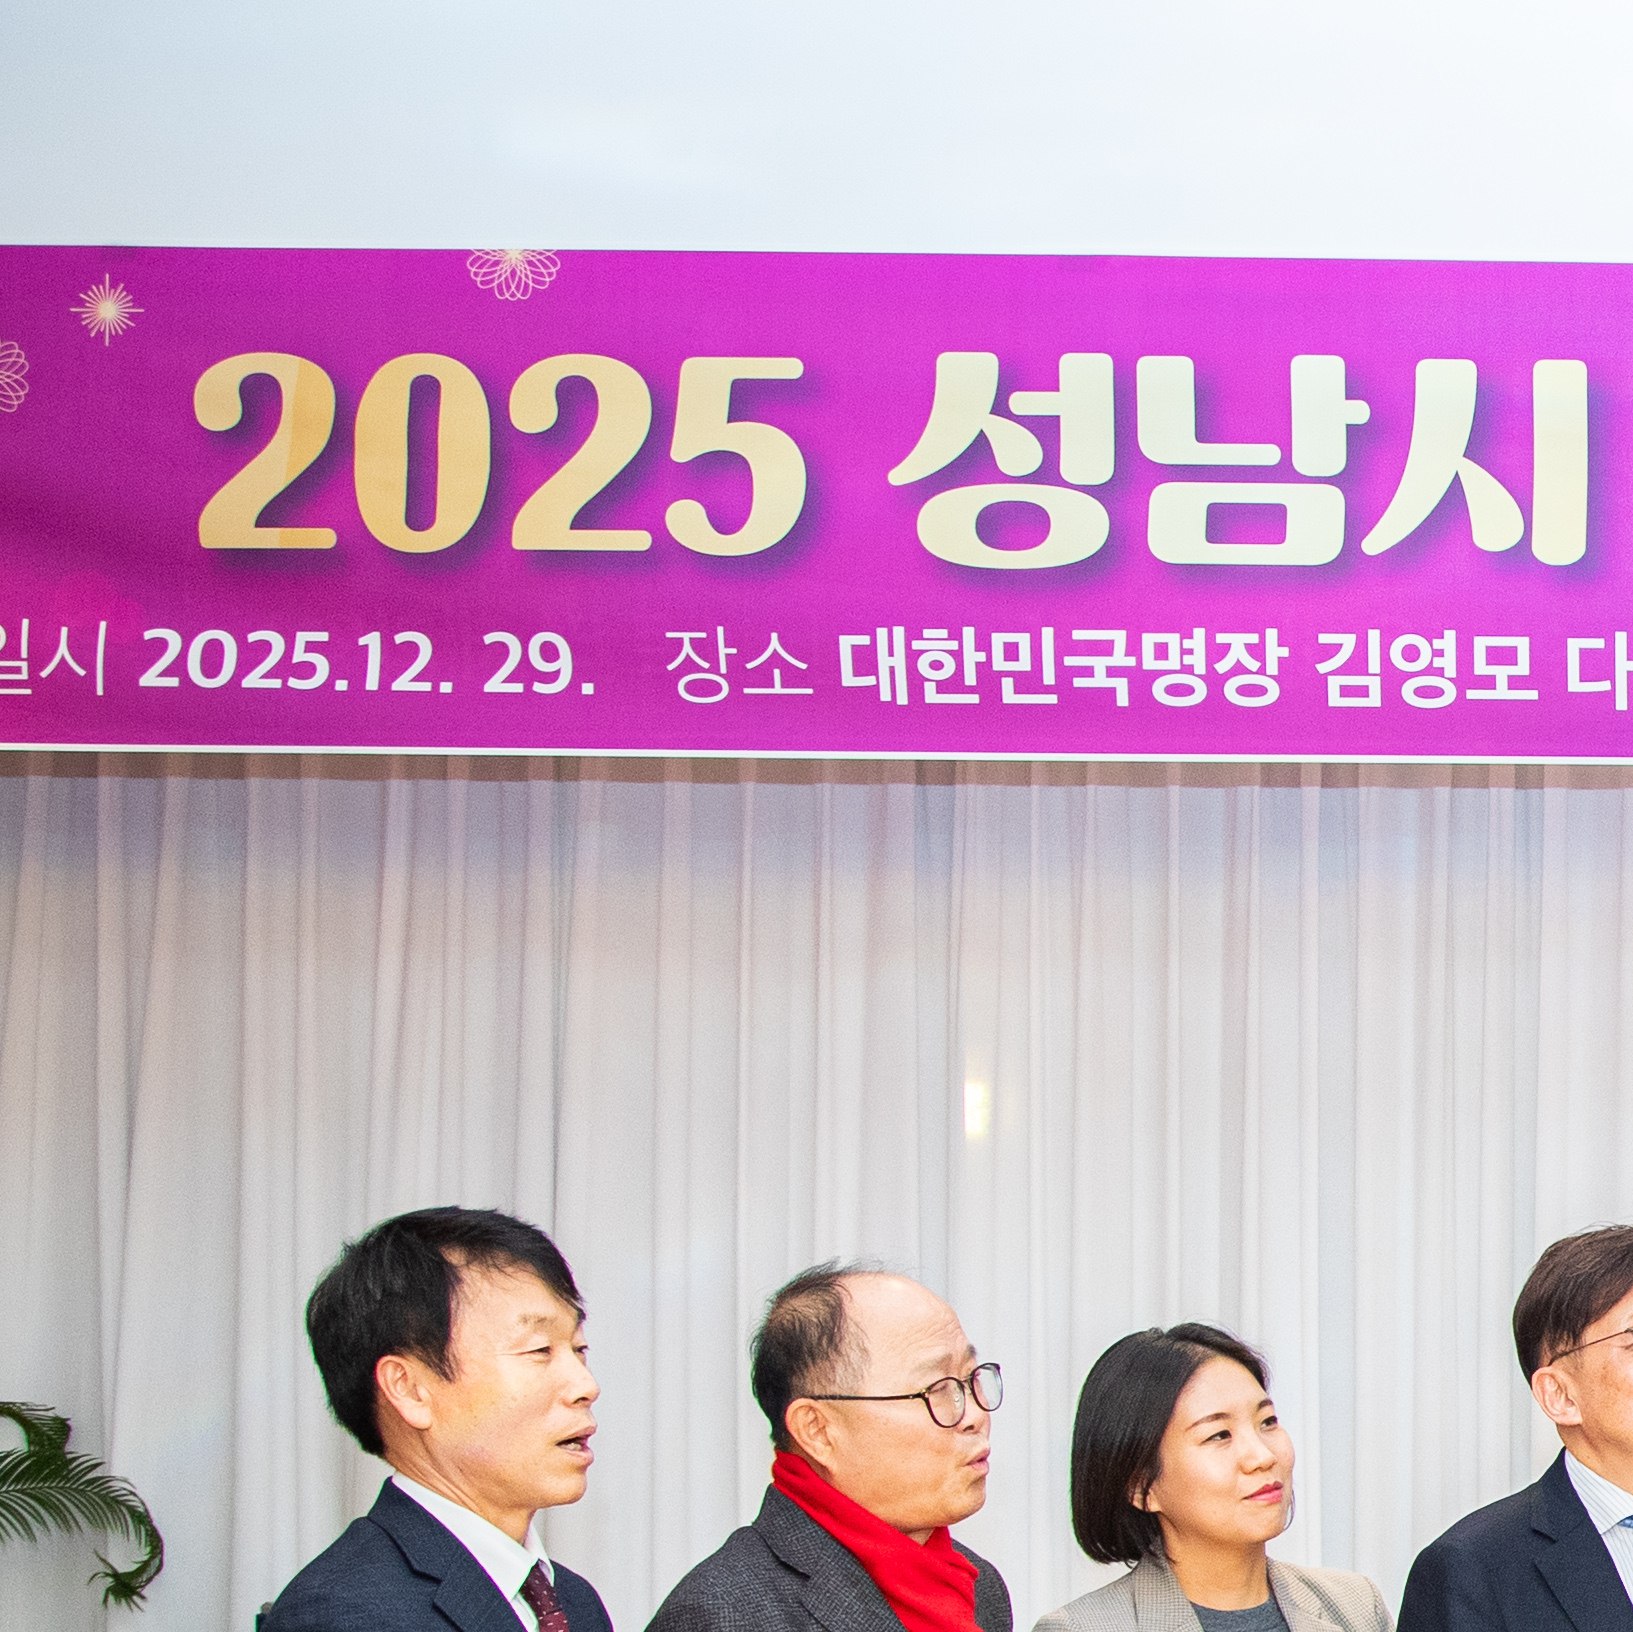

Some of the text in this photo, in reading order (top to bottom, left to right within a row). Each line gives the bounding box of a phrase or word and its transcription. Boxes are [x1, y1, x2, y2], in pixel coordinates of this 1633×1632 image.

[194, 353, 806, 556] 2025
[888, 352, 1588, 569] 성남시
[140, 629, 452, 693] 2025.12.
[484, 632, 594, 694] 29.
[666, 626, 813, 703] 장소
[839, 626, 1289, 707] 대한민국명장
[1315, 629, 1538, 708] 김영모
